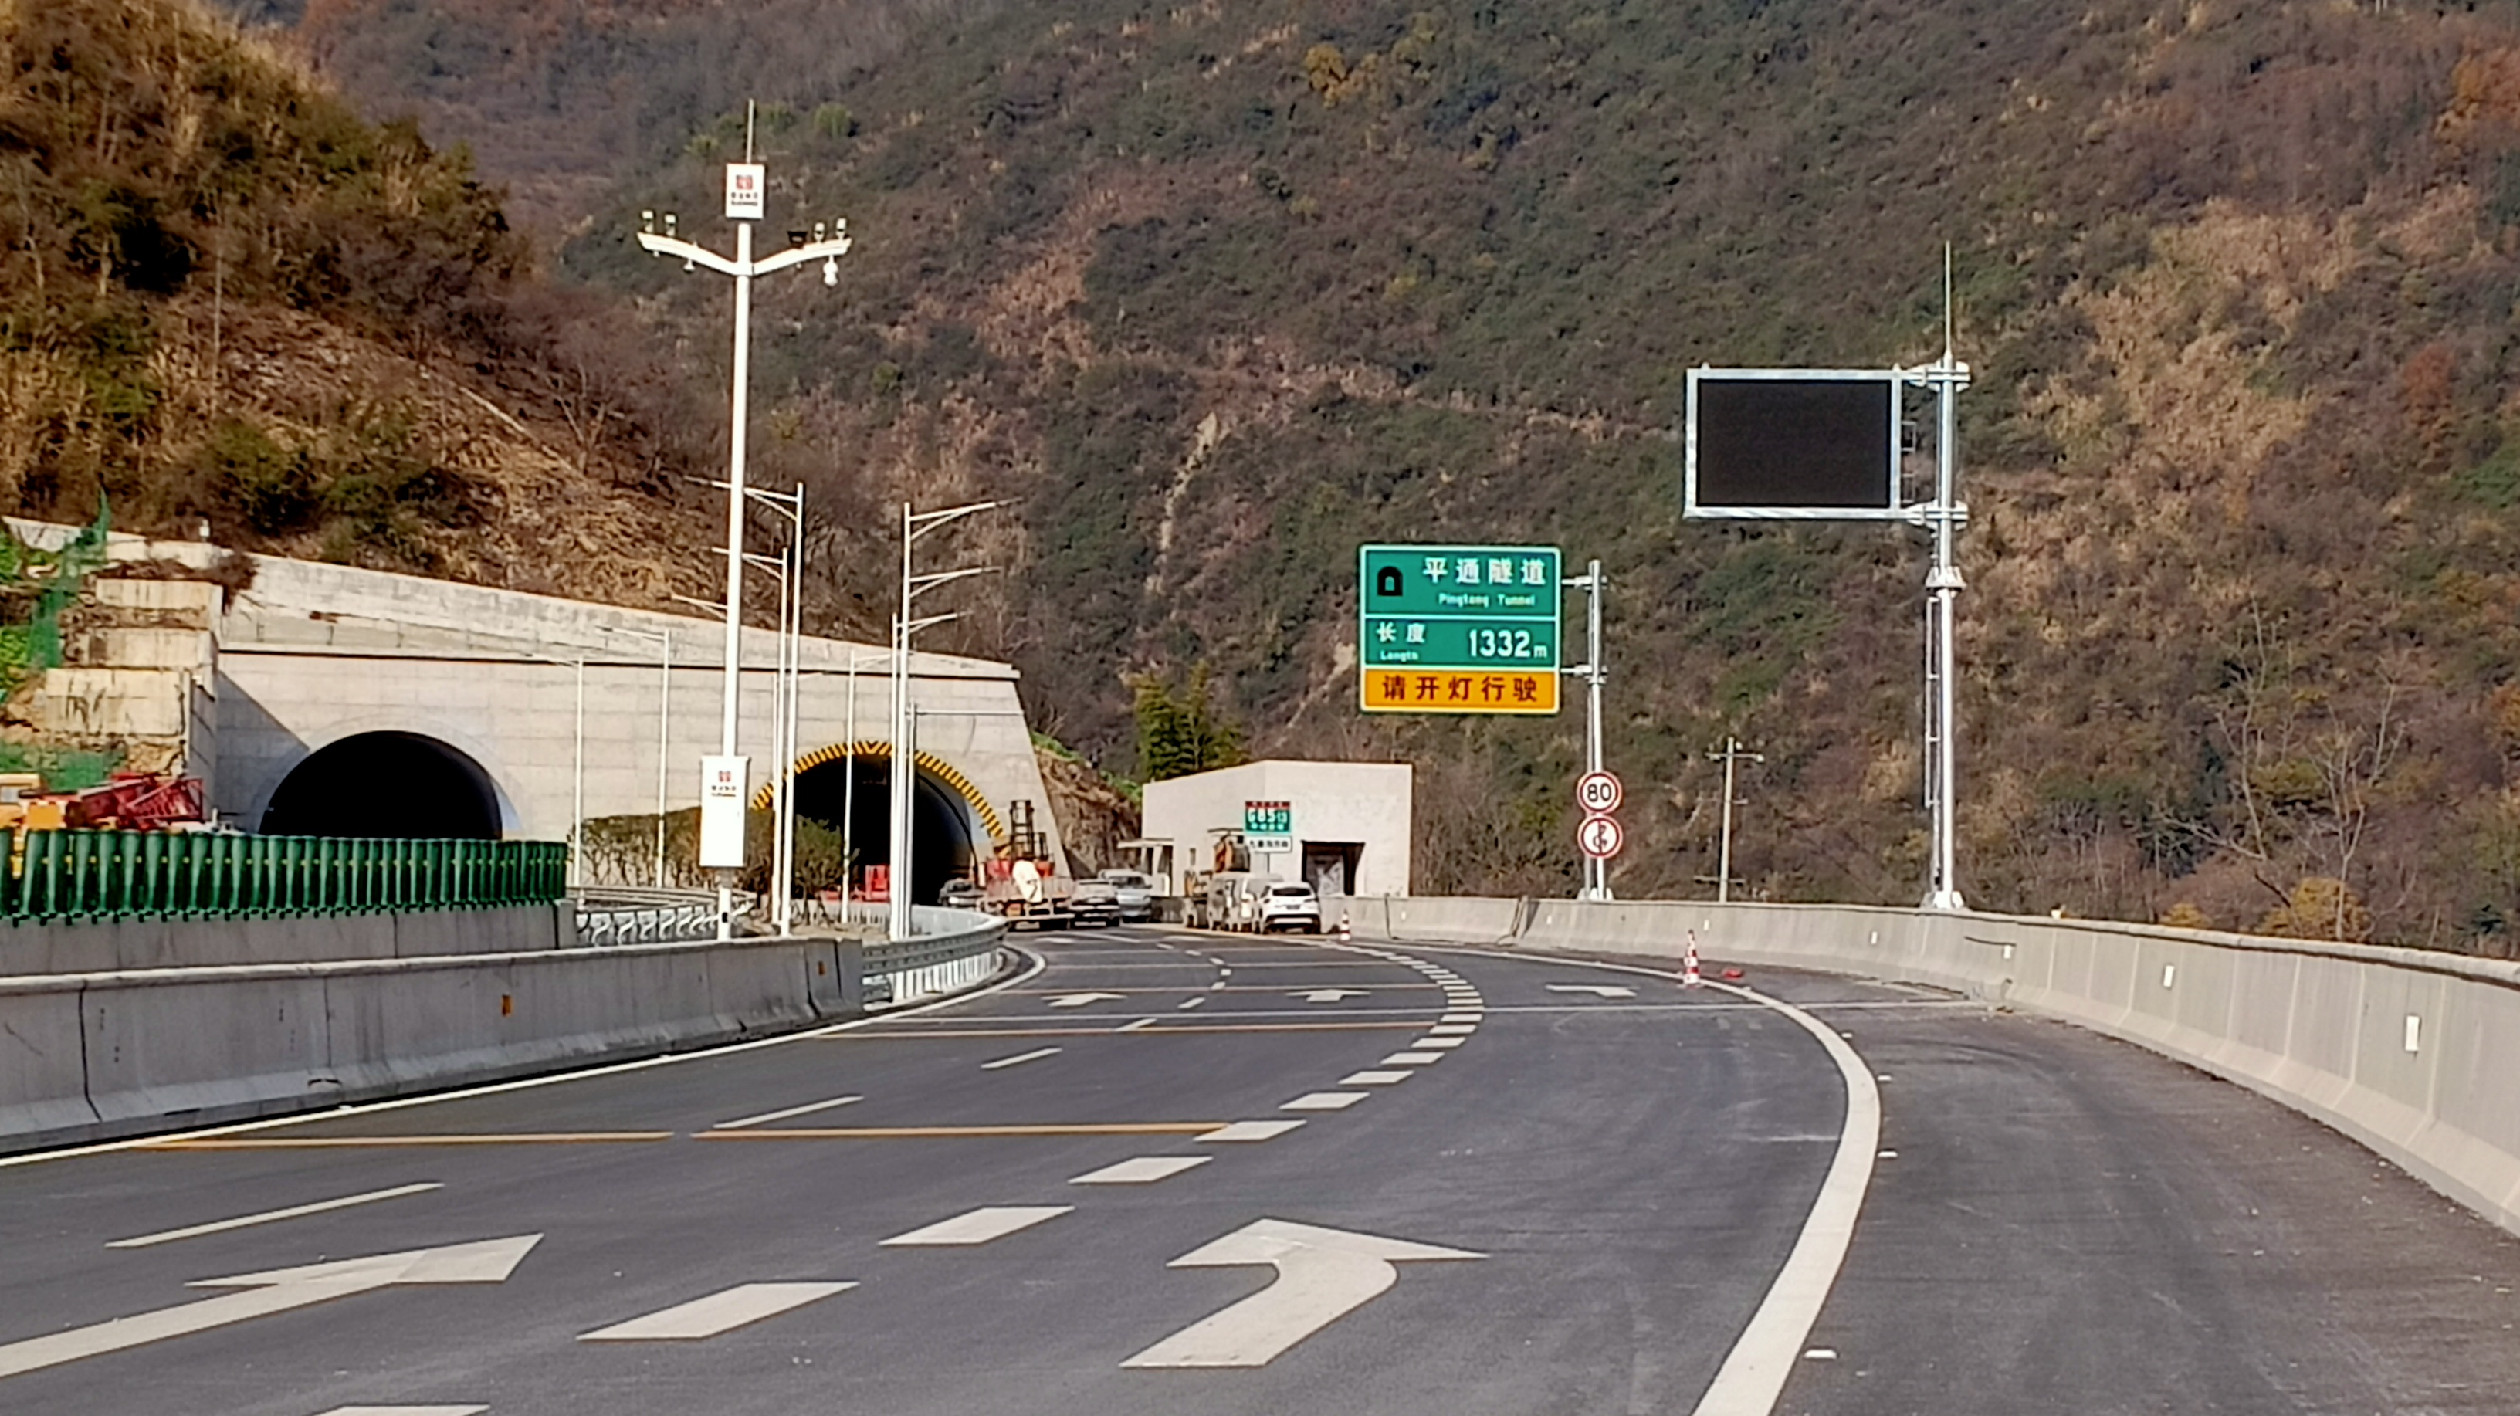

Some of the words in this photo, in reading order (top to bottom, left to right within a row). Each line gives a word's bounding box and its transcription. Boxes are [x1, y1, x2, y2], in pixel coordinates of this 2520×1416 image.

[1423, 556, 1546, 585] 平通隧道
[1498, 594, 1535, 606] Tunnel
[1377, 622, 1426, 643] 长度
[1380, 650, 1418, 662] Length
[1382, 675, 1537, 702] 请开灯行驶
[1587, 783, 1612, 802] 80
